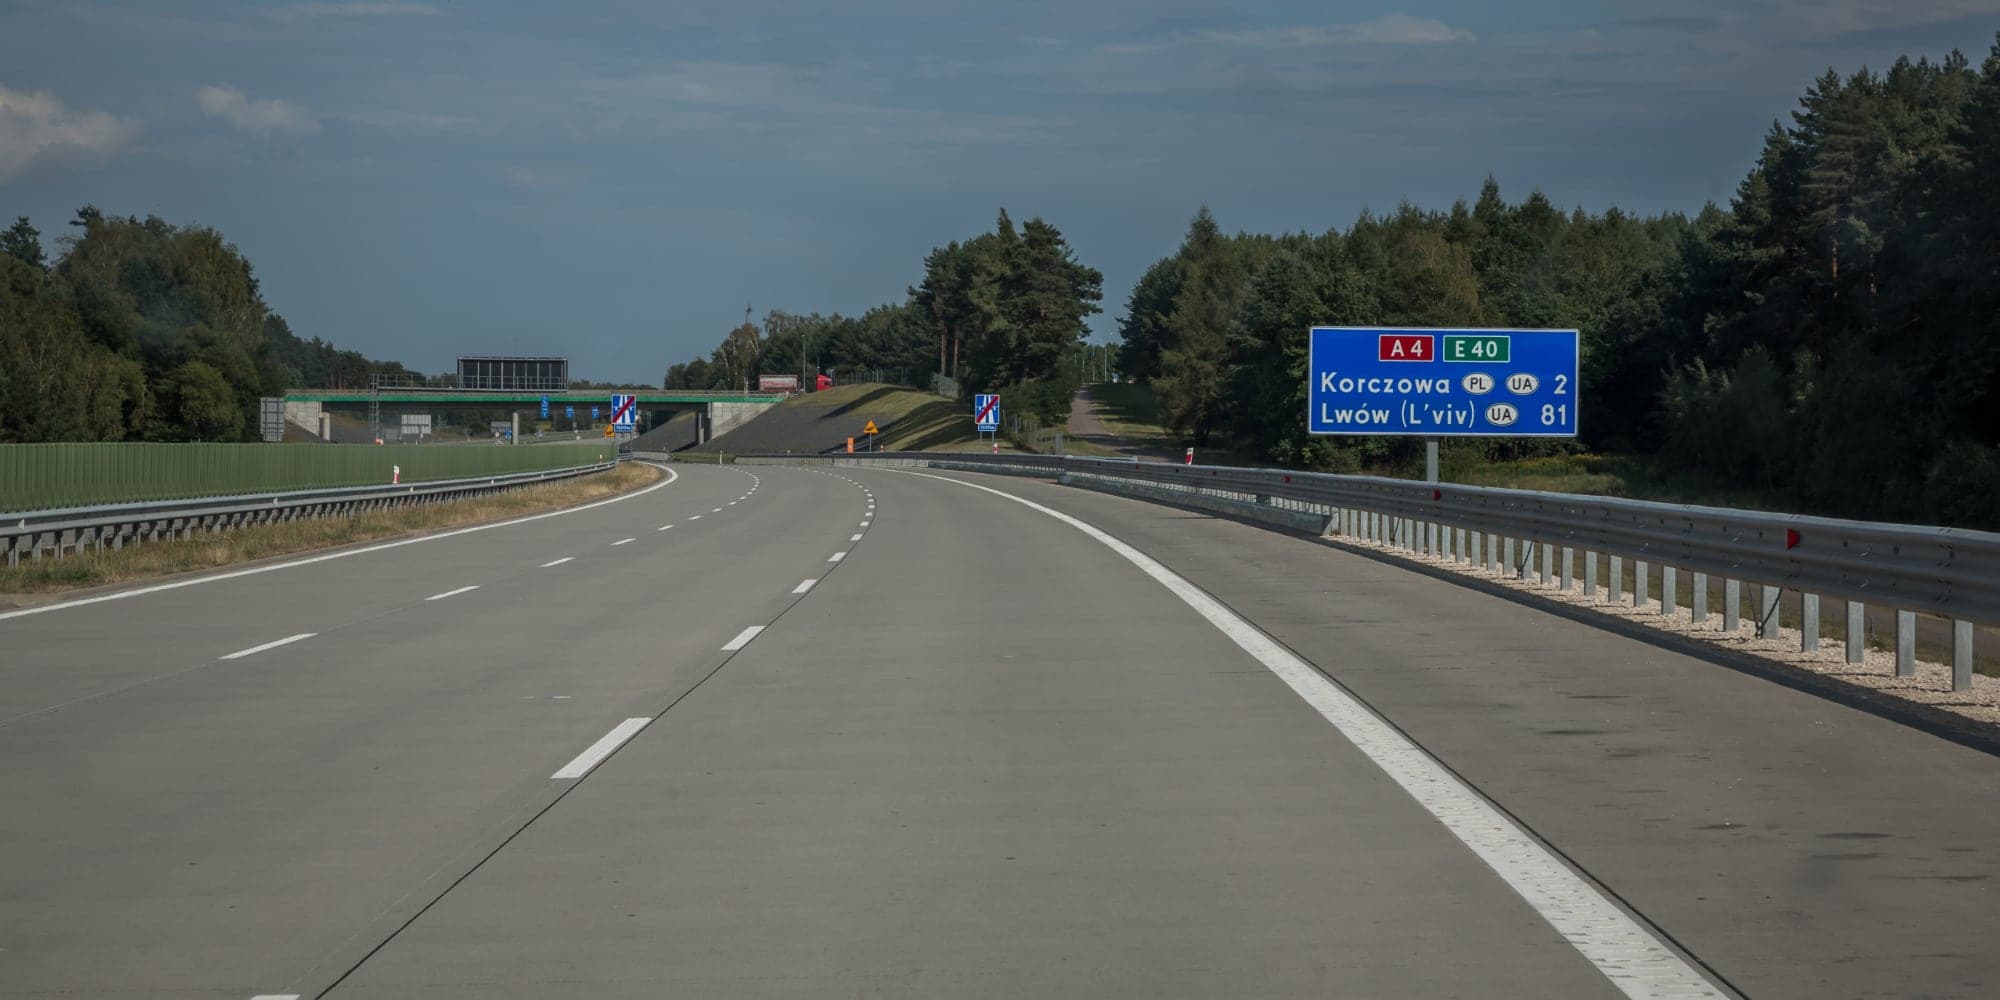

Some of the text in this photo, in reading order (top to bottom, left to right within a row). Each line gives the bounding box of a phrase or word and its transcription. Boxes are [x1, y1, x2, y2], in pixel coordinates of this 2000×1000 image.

[1455, 340, 1498, 357] E 40
[1321, 371, 1568, 394] Korczowa PL UA 2
[1321, 399, 1566, 428] Lwów (L'viv) UA 81
